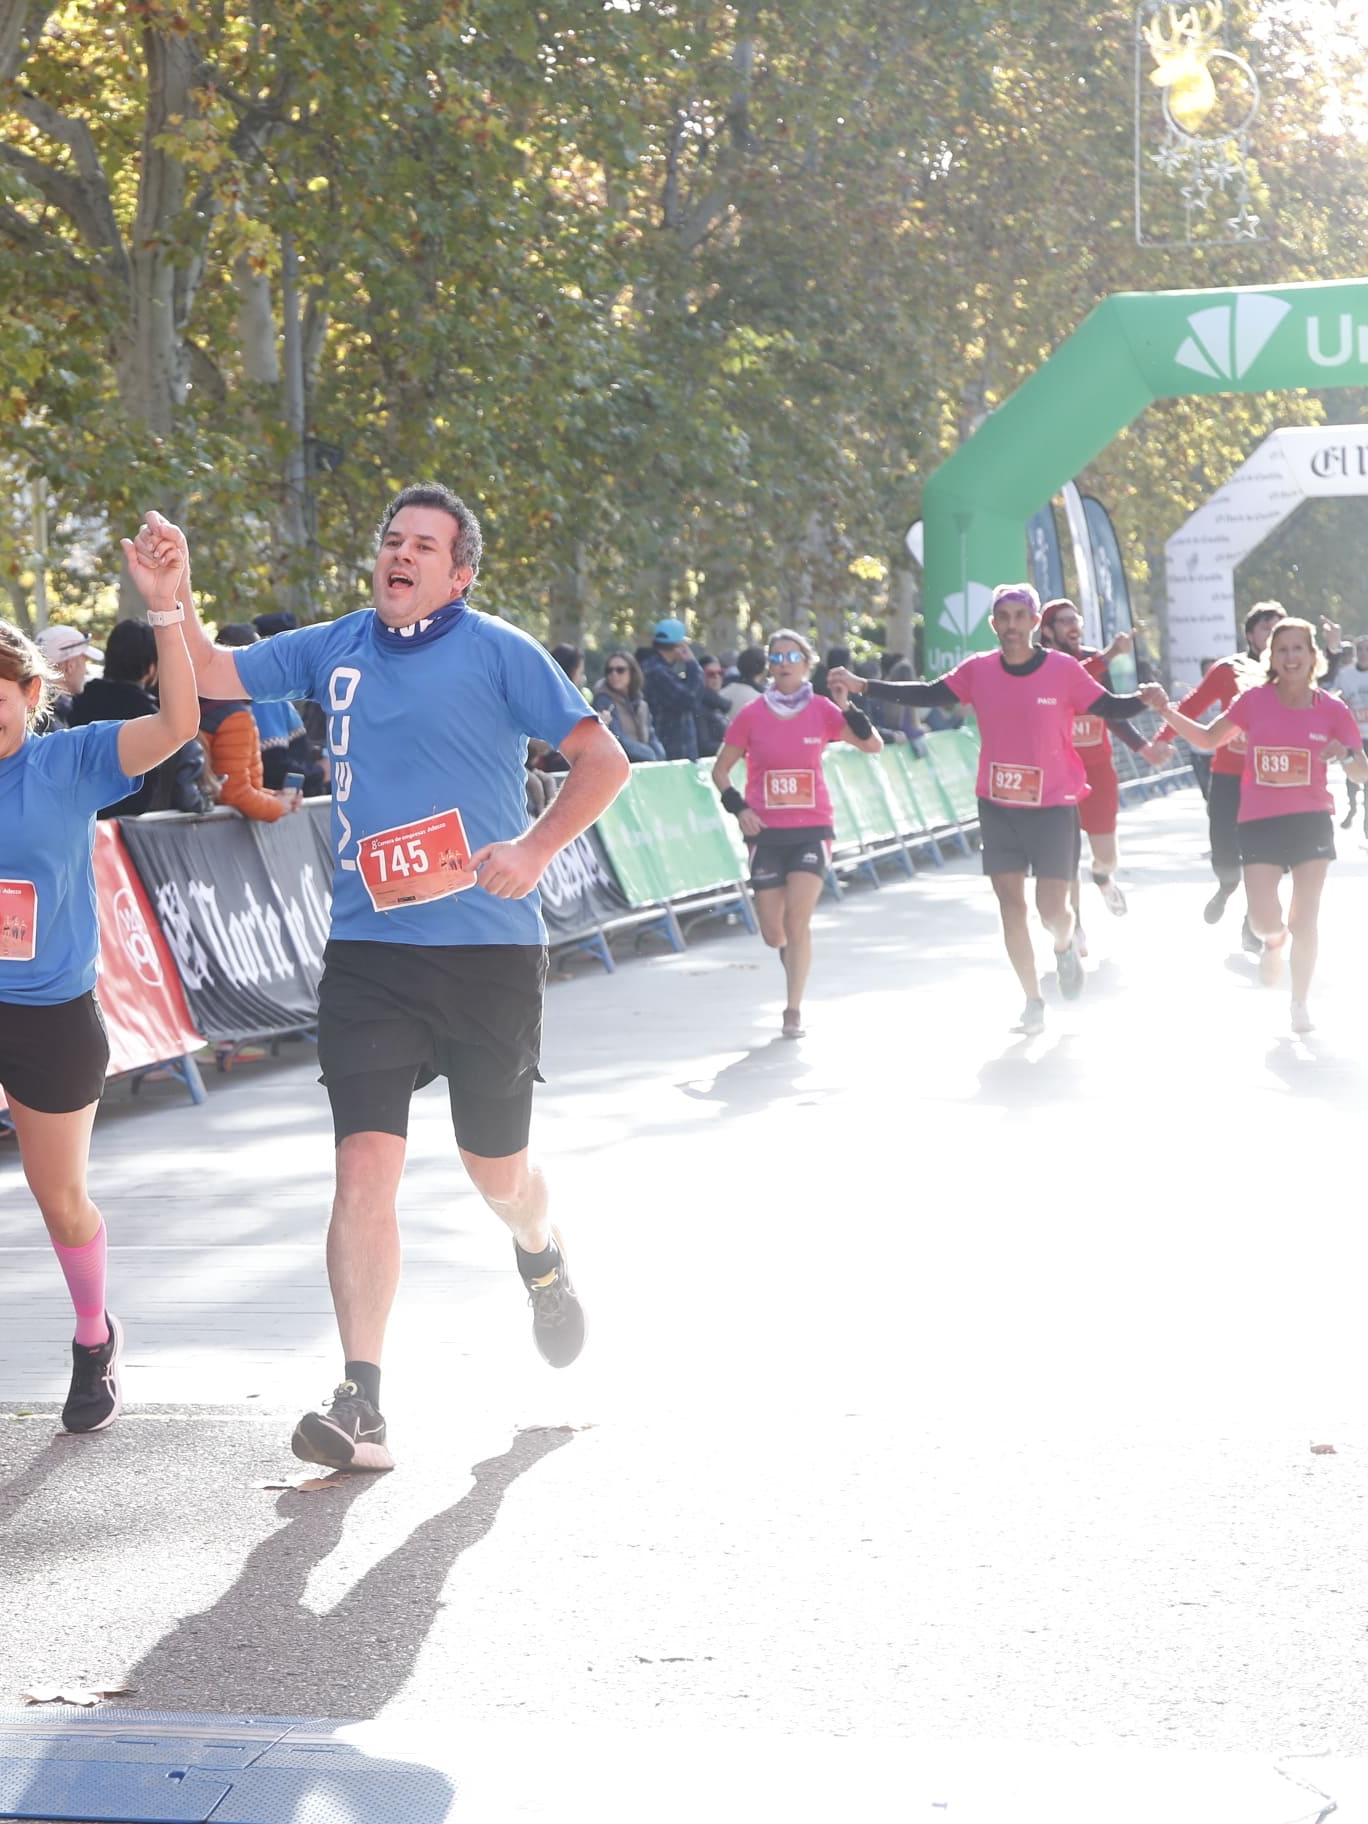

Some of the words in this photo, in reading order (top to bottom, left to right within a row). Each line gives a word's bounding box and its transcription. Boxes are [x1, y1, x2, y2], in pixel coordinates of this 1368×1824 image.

[329, 667, 362, 871] IVECO
[1261, 754, 1289, 772] 839
[771, 777, 797, 795] 838
[996, 771, 1023, 790] 922
[370, 839, 430, 882] 745
